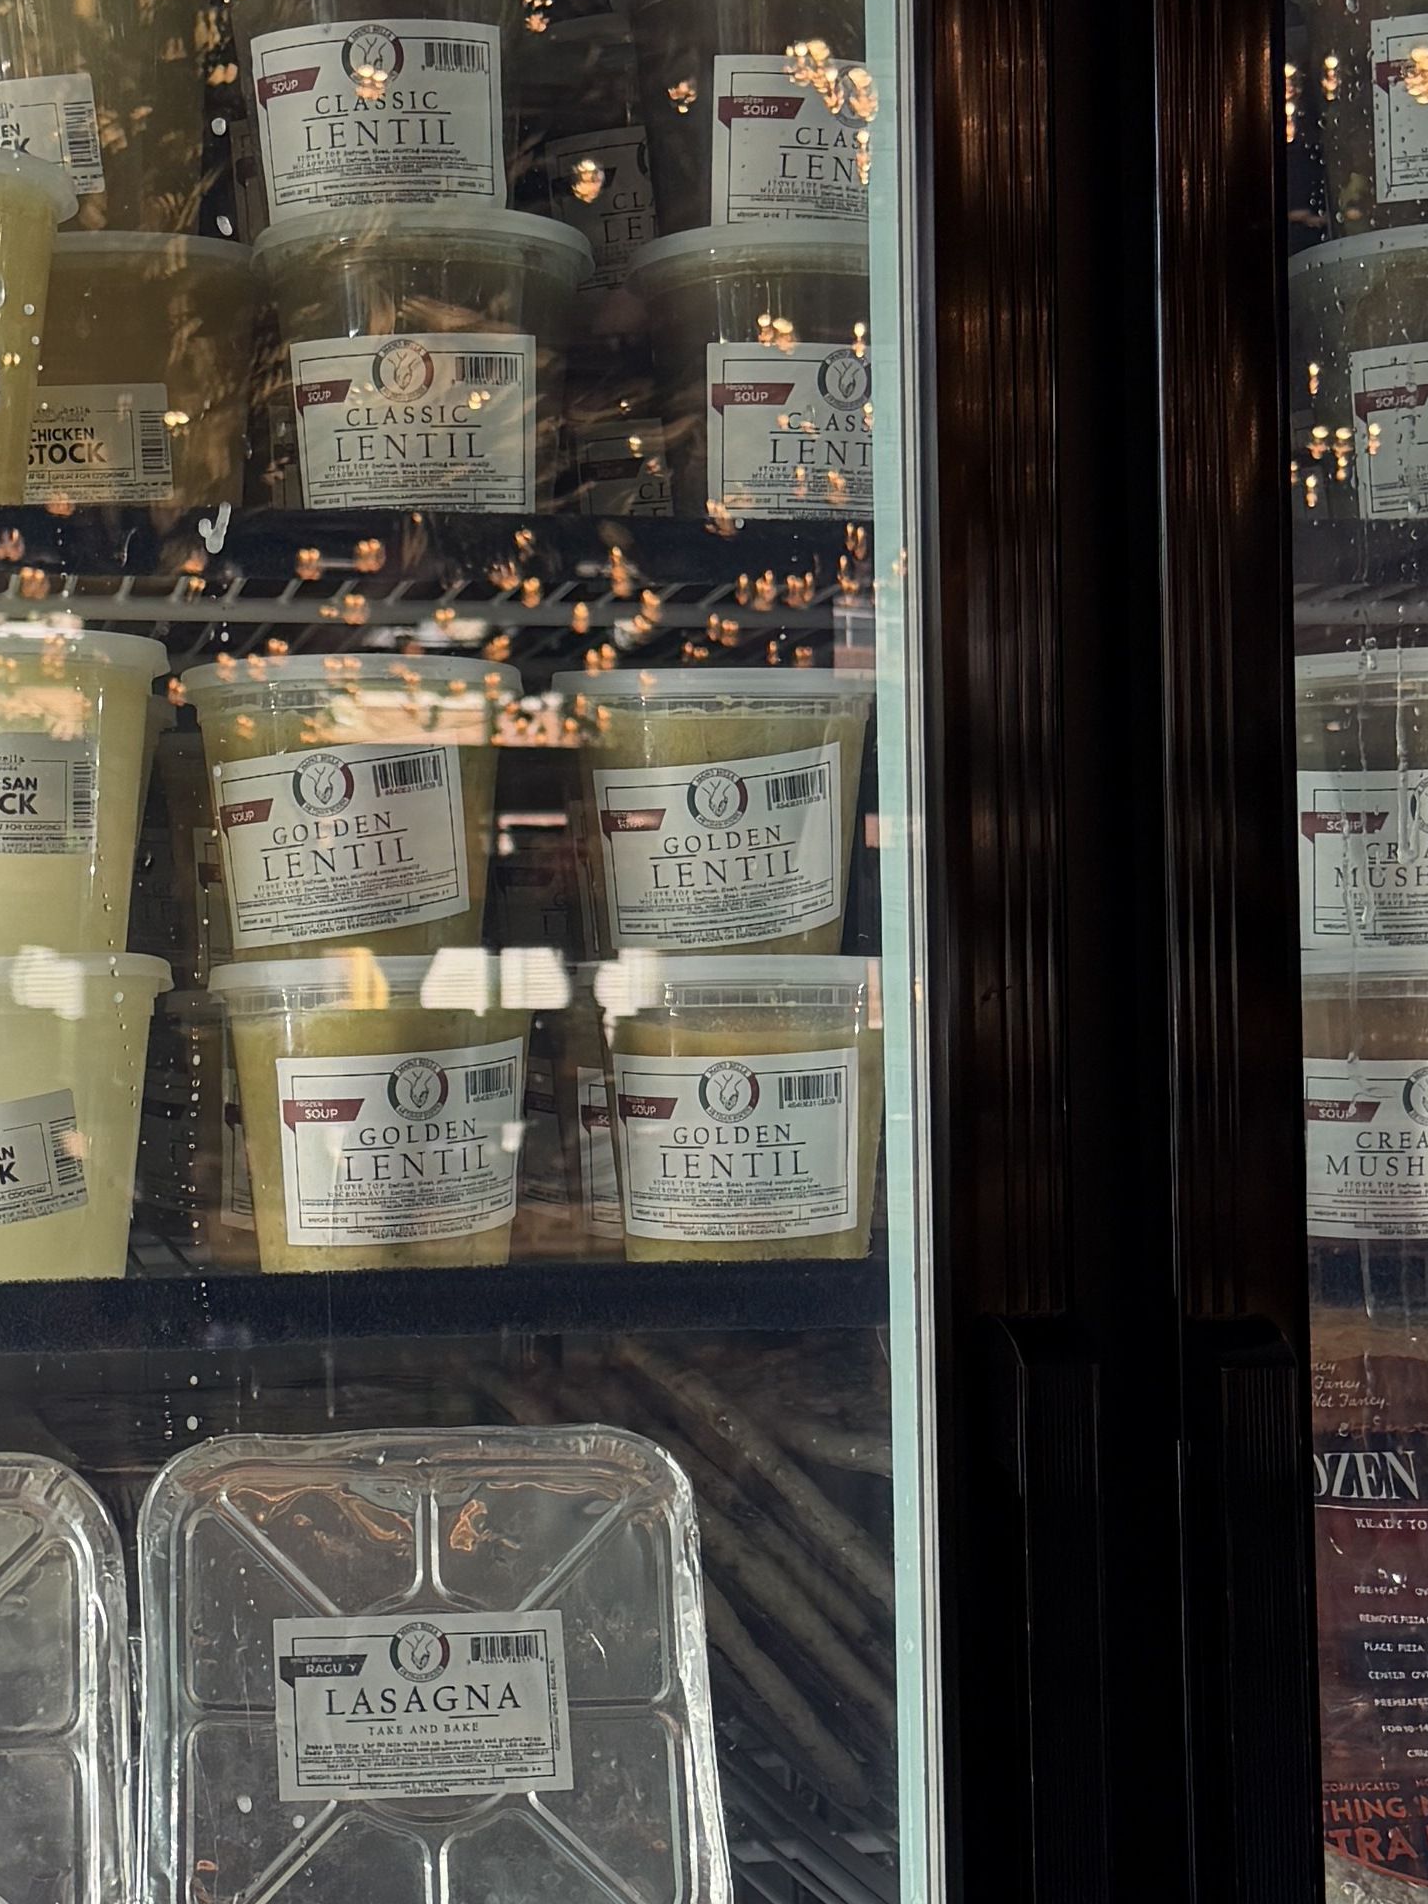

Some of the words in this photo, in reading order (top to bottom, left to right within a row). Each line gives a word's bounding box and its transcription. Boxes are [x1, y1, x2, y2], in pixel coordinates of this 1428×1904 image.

[272, 79, 298, 94] SOUP
[315, 91, 440, 115] CLASSIC
[743, 104, 779, 117] SOUP
[303, 118, 457, 152] LENTIL
[734, 391, 768, 403] SOUP
[345, 405, 470, 428] CLASSIC
[334, 430, 485, 462] LENTIL
[272, 808, 394, 847] GOLDEN
[663, 823, 783, 856] GOLDEN
[261, 834, 415, 884] LENTIL
[651, 851, 801, 889] LENTIL
[305, 1107, 340, 1121] SOUP
[631, 1104, 656, 1117] SOUP
[357, 1117, 478, 1146] GOLDEN
[672, 1122, 793, 1147] GOLDEN
[342, 1145, 491, 1182] LENTIL
[658, 1148, 811, 1178] LENTIL
[1408, 1519, 1427, 1530] TO
[306, 1663, 343, 1675] RAGU
[325, 1682, 521, 1716] LASAGNA
